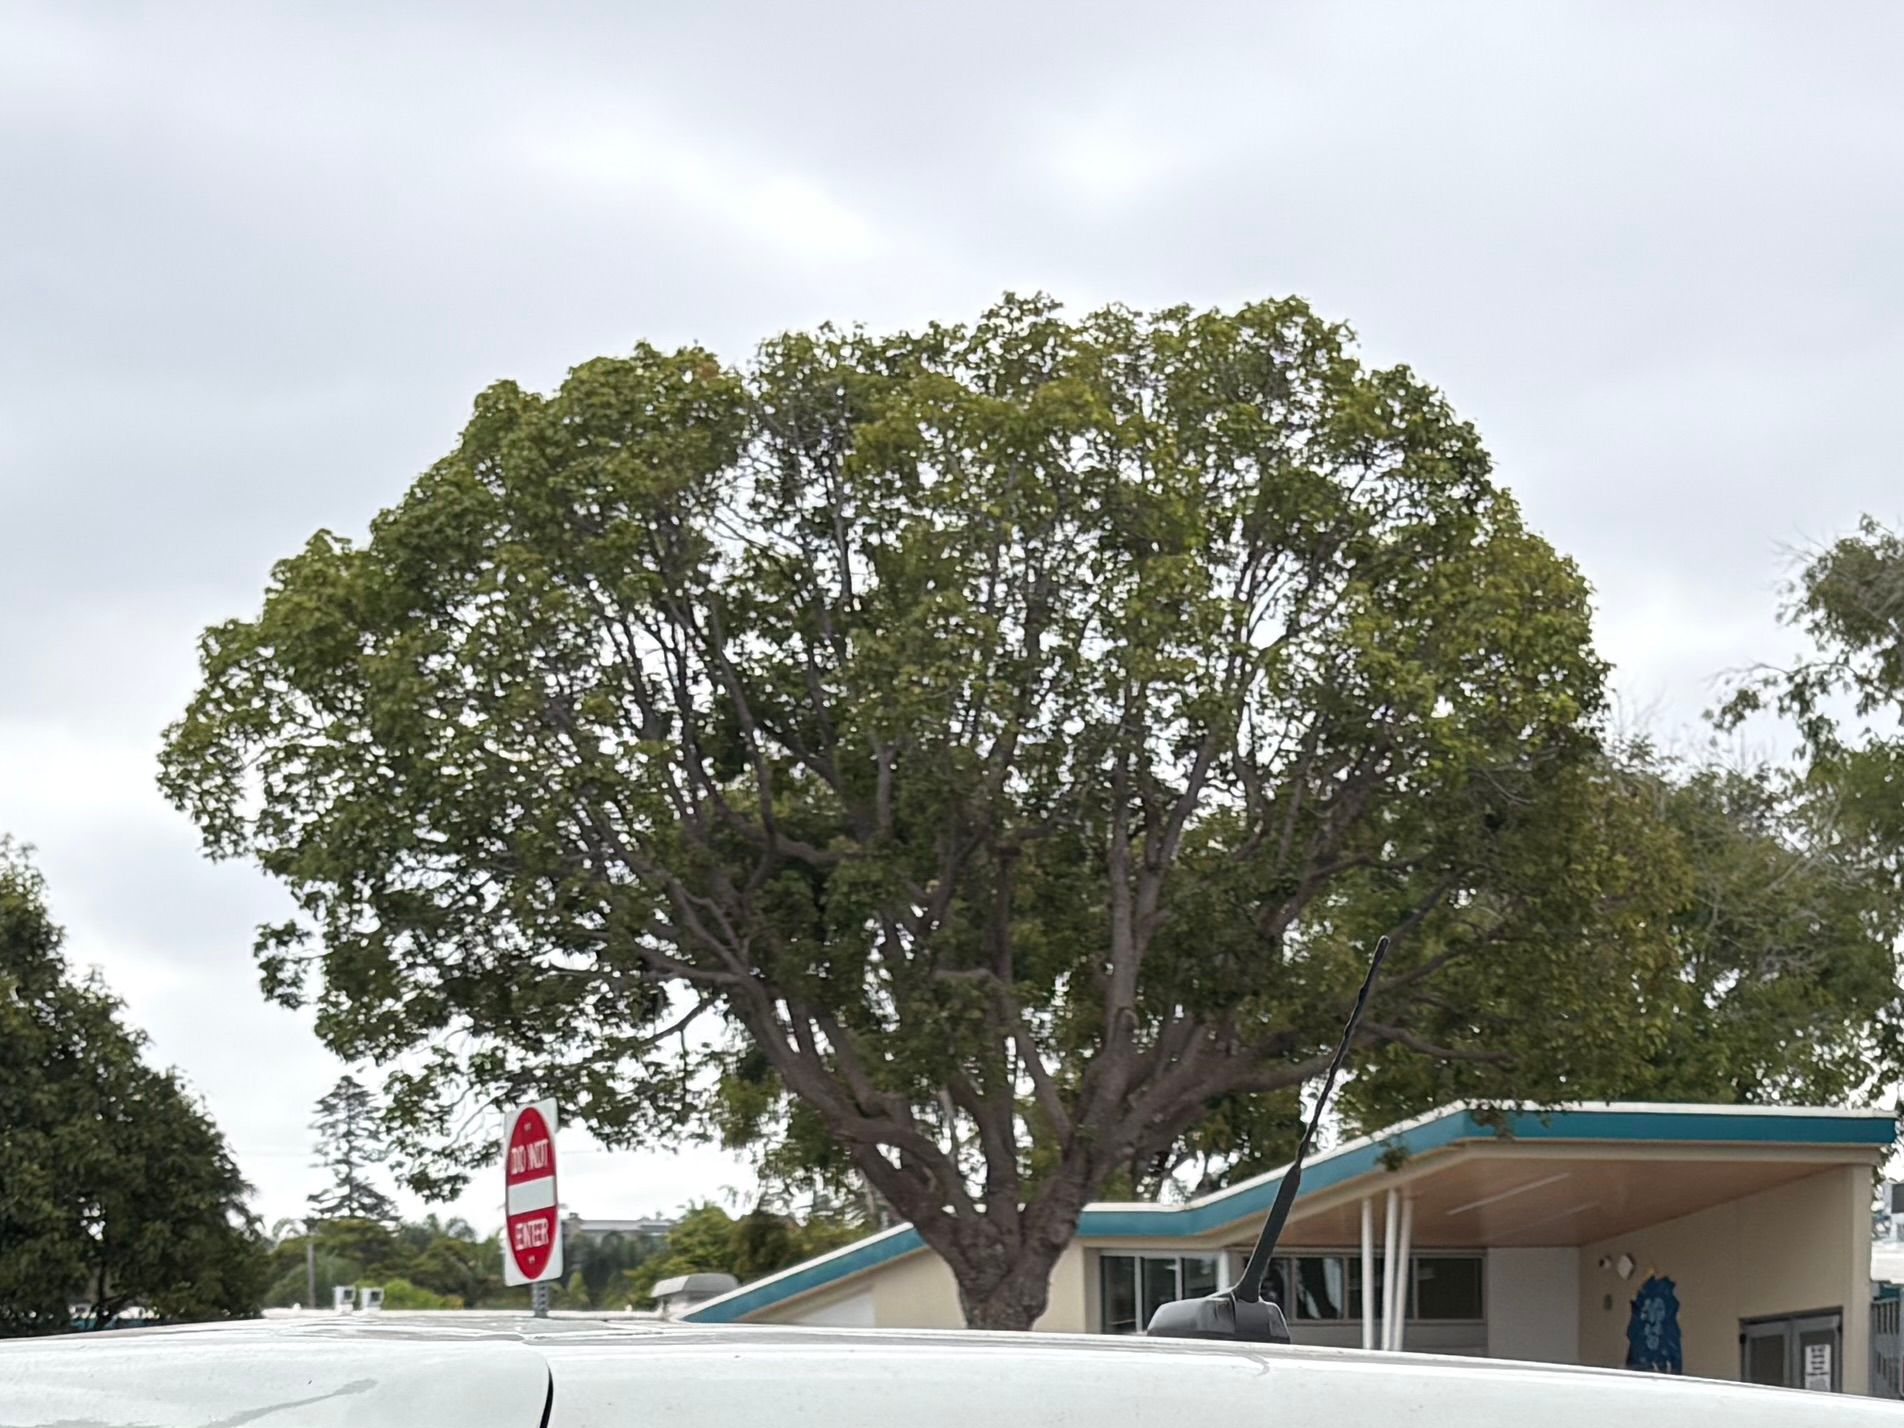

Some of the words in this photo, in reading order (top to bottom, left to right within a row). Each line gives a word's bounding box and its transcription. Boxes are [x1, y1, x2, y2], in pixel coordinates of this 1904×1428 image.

[511, 1145, 526, 1175] DO
[527, 1139, 549, 1172] NOT
[515, 1218, 549, 1251] ENTER
